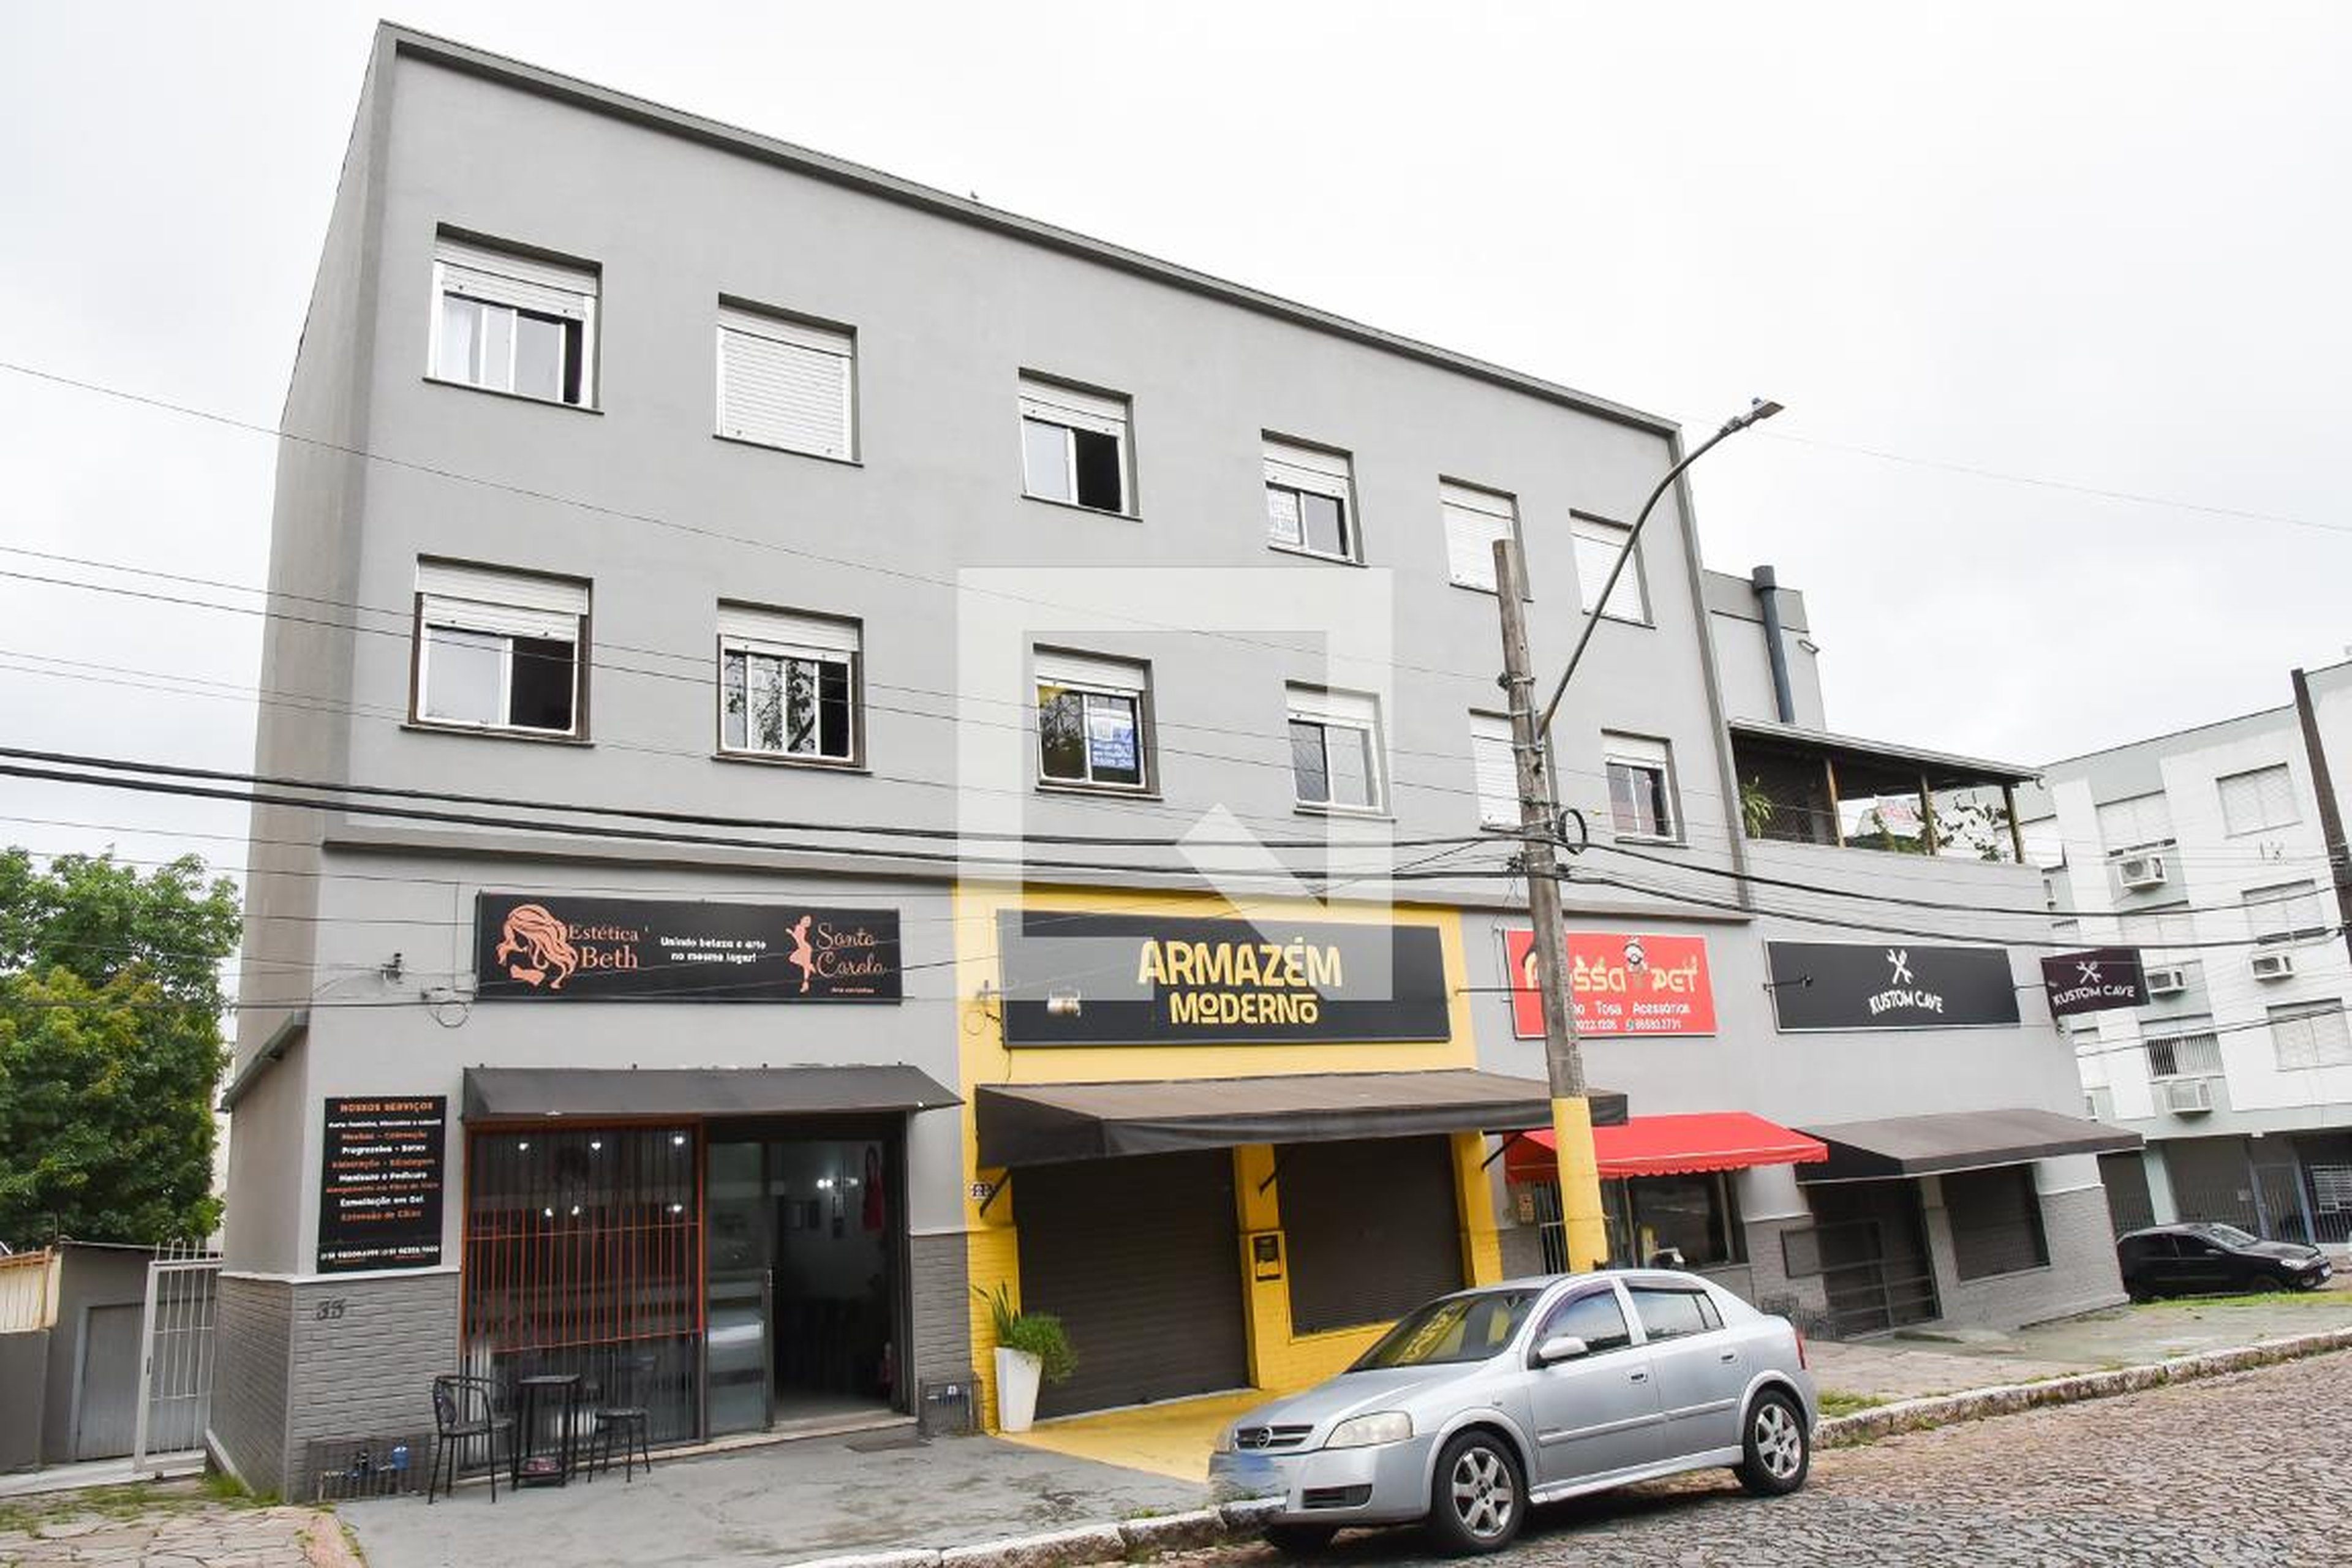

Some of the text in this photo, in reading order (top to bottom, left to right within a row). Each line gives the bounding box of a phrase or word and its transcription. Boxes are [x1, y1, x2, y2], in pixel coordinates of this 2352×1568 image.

[568, 925, 639, 941] Estética
[699, 938, 733, 948] beleza
[581, 945, 638, 968] Beth
[687, 953, 723, 962] mesmo
[1137, 937, 1343, 987] ARMAZÉM
[1869, 990, 1944, 1016] KUSTOM CAVE
[2052, 984, 2135, 1006] KUSTOM CAVE
[1170, 992, 1319, 1024] MODERNO
